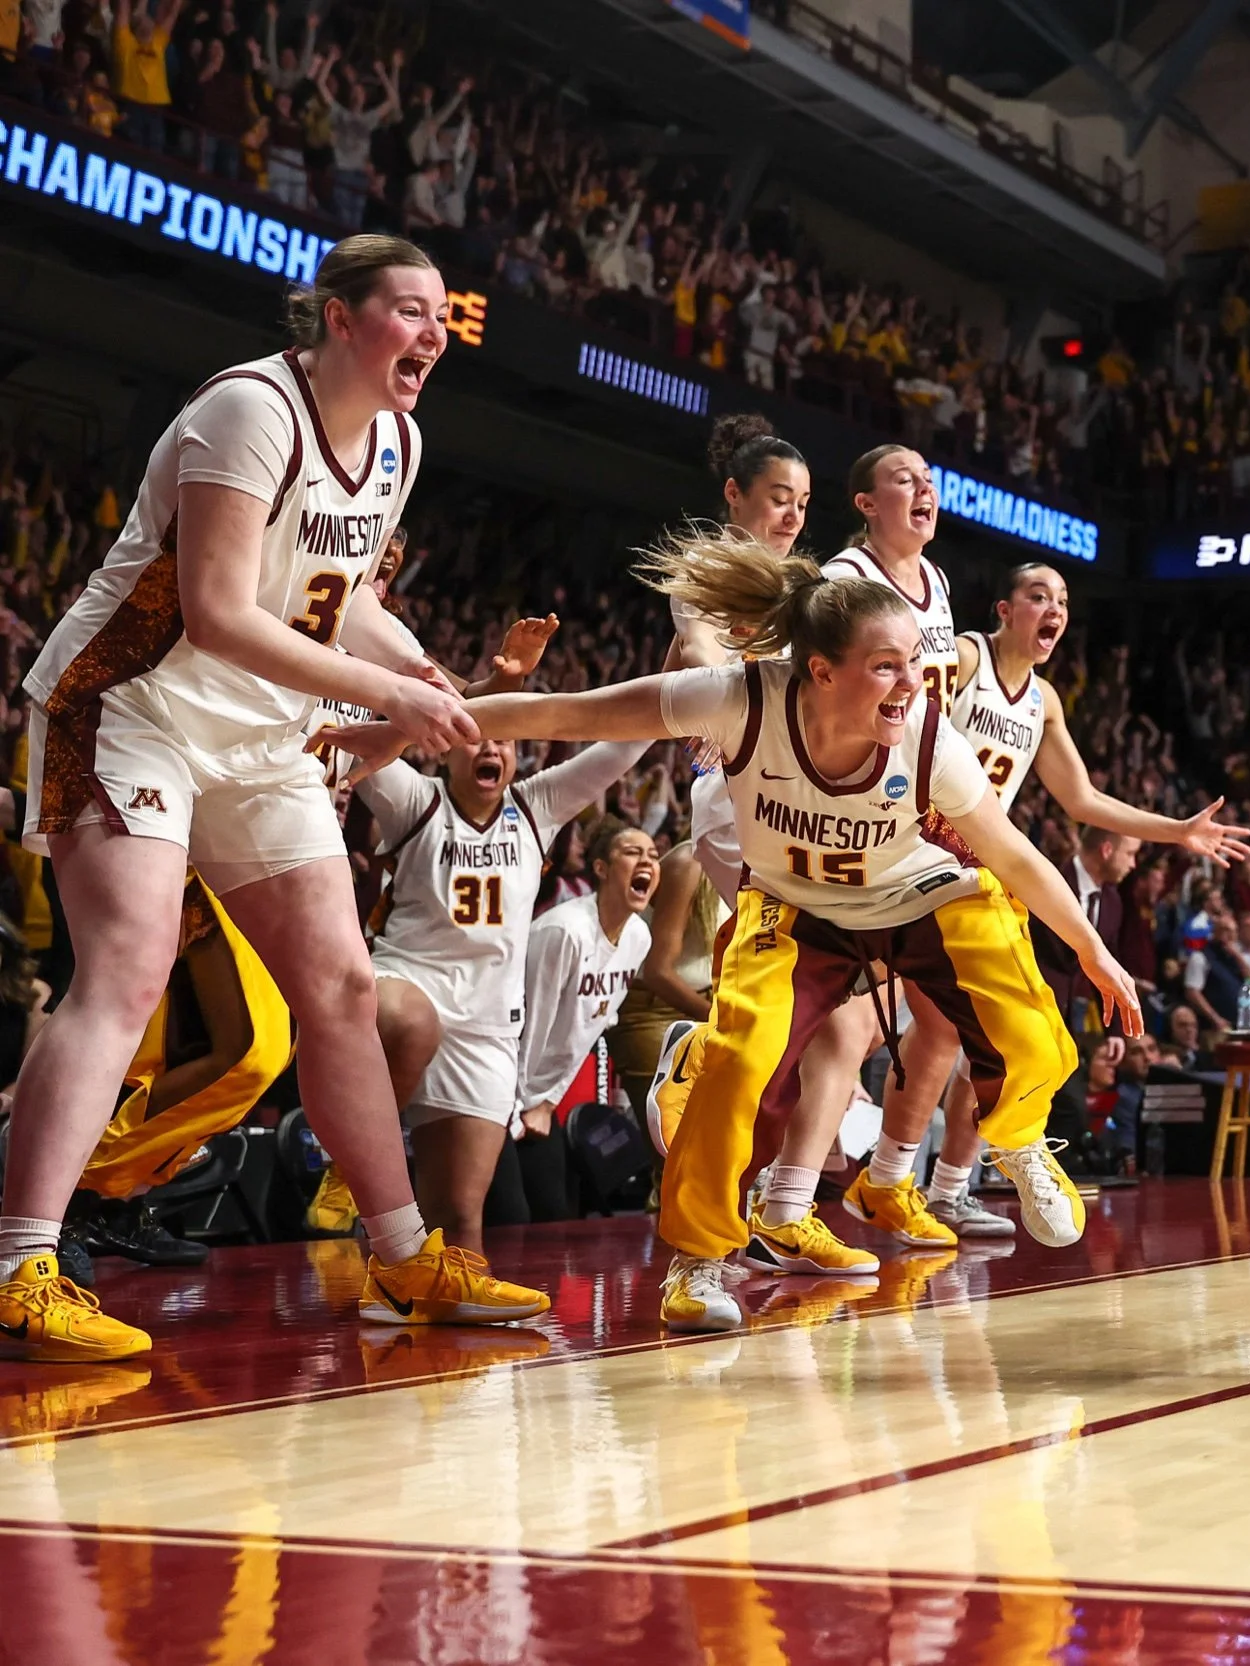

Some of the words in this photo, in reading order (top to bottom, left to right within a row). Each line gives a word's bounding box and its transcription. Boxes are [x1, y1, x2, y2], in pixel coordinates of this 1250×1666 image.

[0, 119, 336, 284] HAMPIONSH
[931, 464, 1098, 562] ARCHMADNESS
[287, 569, 364, 646] 3
[755, 792, 897, 850] MINNESOTA
[439, 840, 518, 868] MNNESOTA
[785, 845, 867, 888] 15
[453, 874, 504, 927] 31
